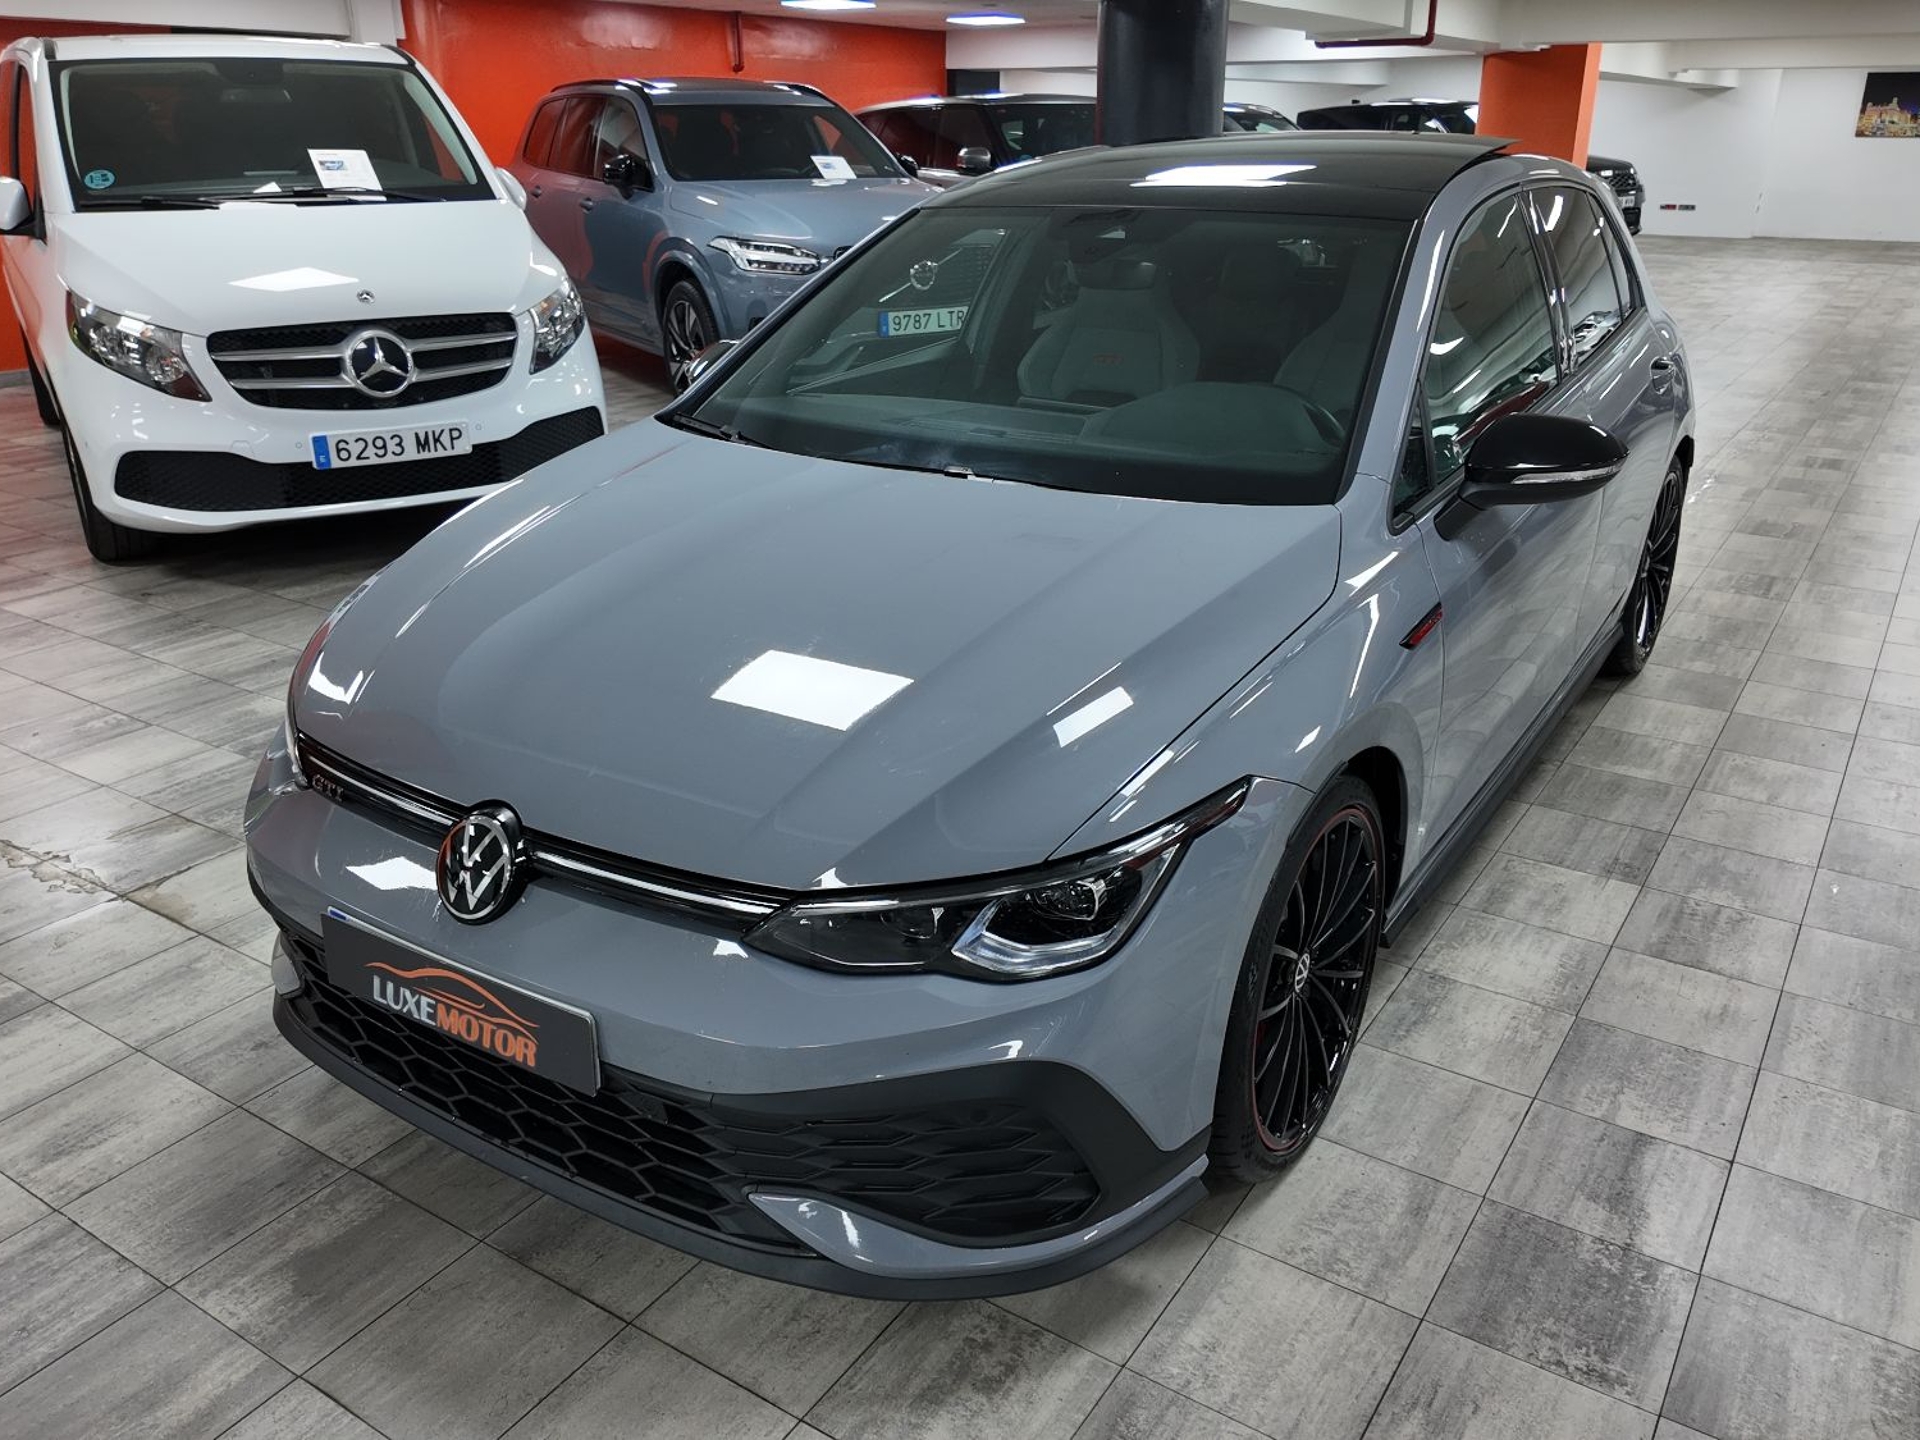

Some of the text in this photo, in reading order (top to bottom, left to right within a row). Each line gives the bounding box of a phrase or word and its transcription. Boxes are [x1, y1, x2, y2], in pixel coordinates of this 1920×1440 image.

[892, 313, 932, 331] 9787
[335, 427, 463, 462] 6293 MKP
